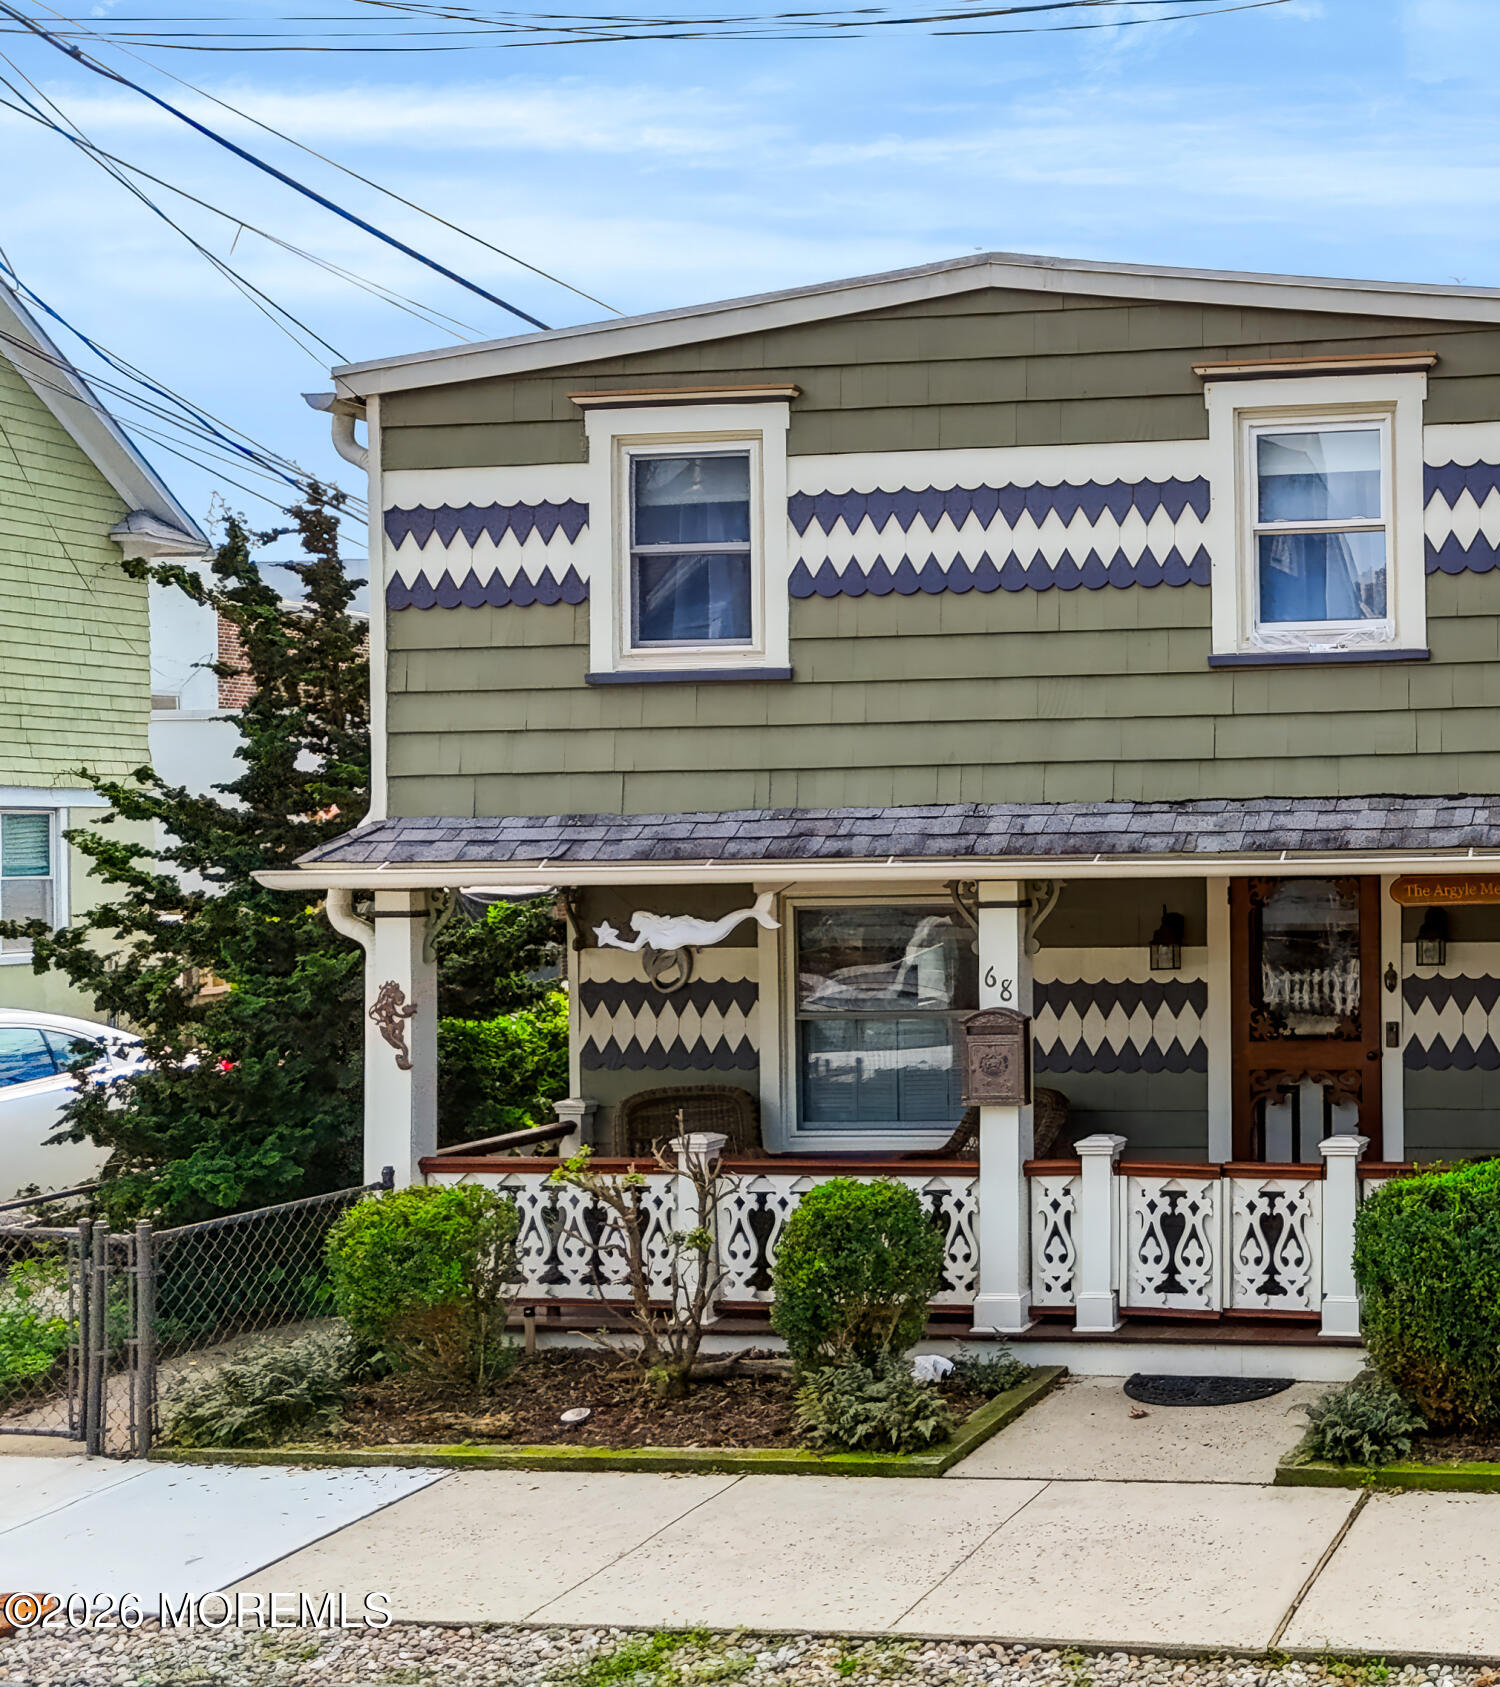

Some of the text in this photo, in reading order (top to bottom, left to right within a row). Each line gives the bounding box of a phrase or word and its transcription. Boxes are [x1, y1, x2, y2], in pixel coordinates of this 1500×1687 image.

[1406, 884, 1431, 897] The
[1433, 882, 1477, 898] Argyle
[984, 965, 1013, 1002] 68
